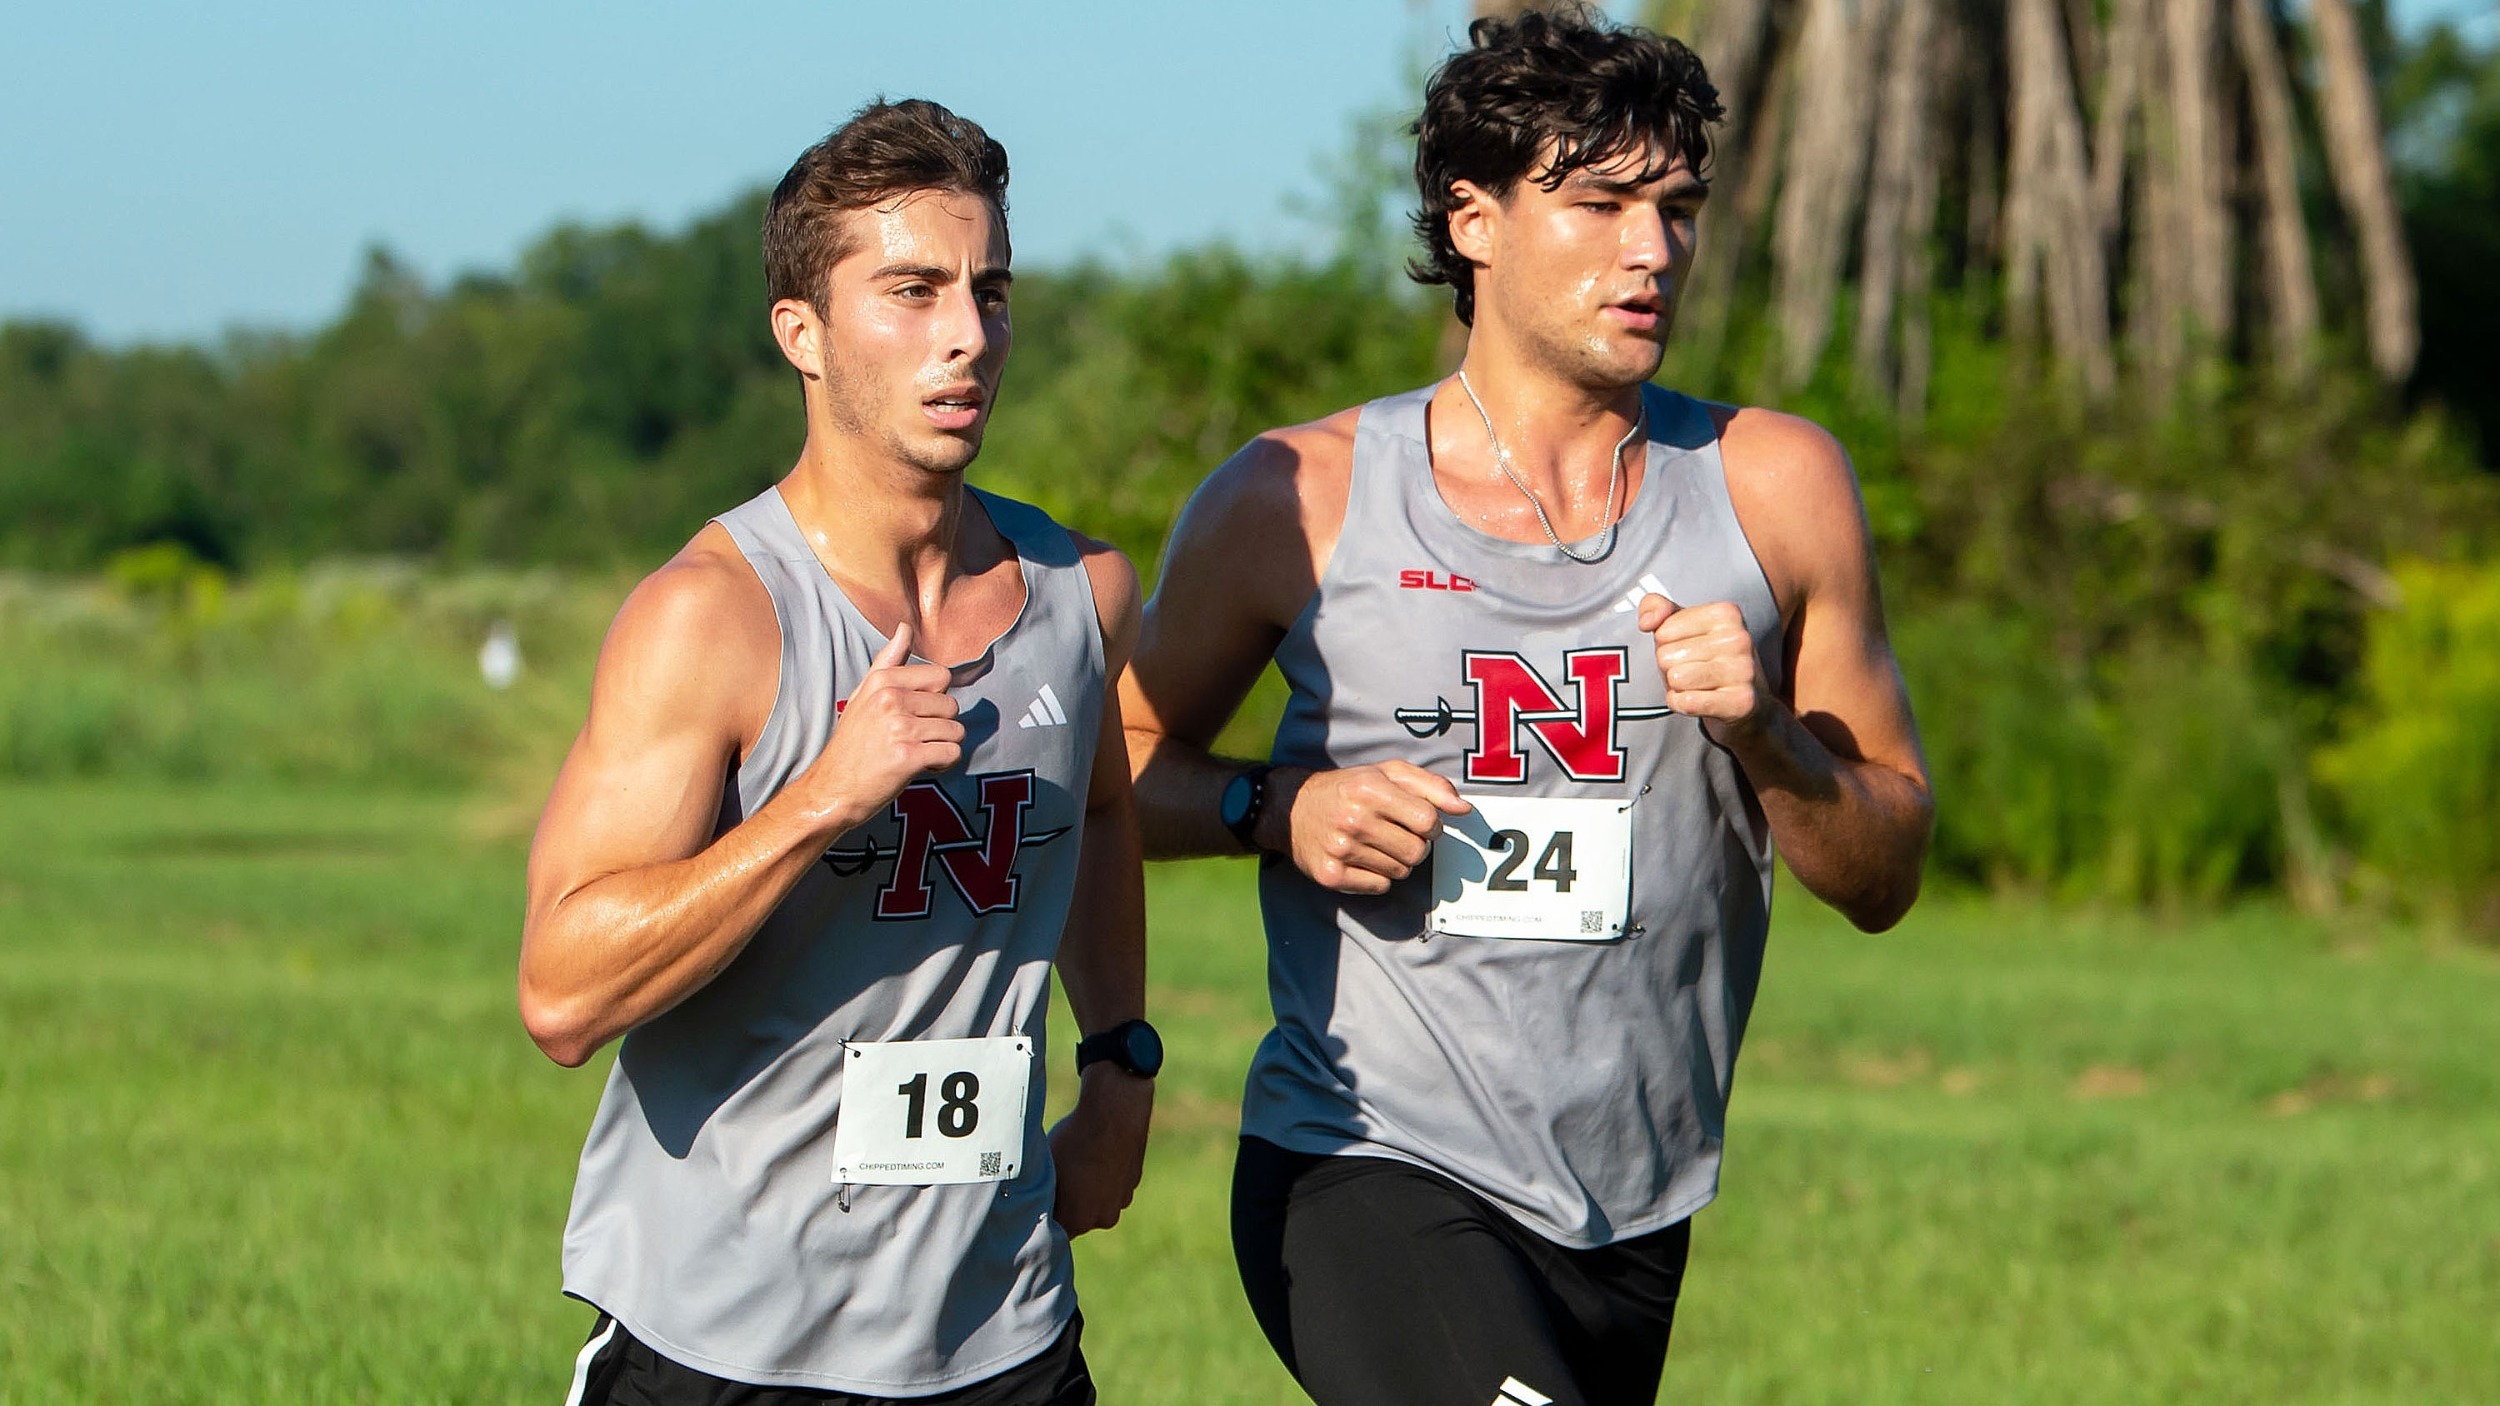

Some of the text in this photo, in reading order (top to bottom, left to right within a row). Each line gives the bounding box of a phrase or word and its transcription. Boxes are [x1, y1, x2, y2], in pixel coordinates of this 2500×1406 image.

[1461, 645, 1630, 785] N
[872, 767, 1037, 922] N
[1486, 828, 1578, 893] 24
[897, 1070, 981, 1139] 18
[858, 1161, 945, 1172] CHIPPEDTIMING.COM
